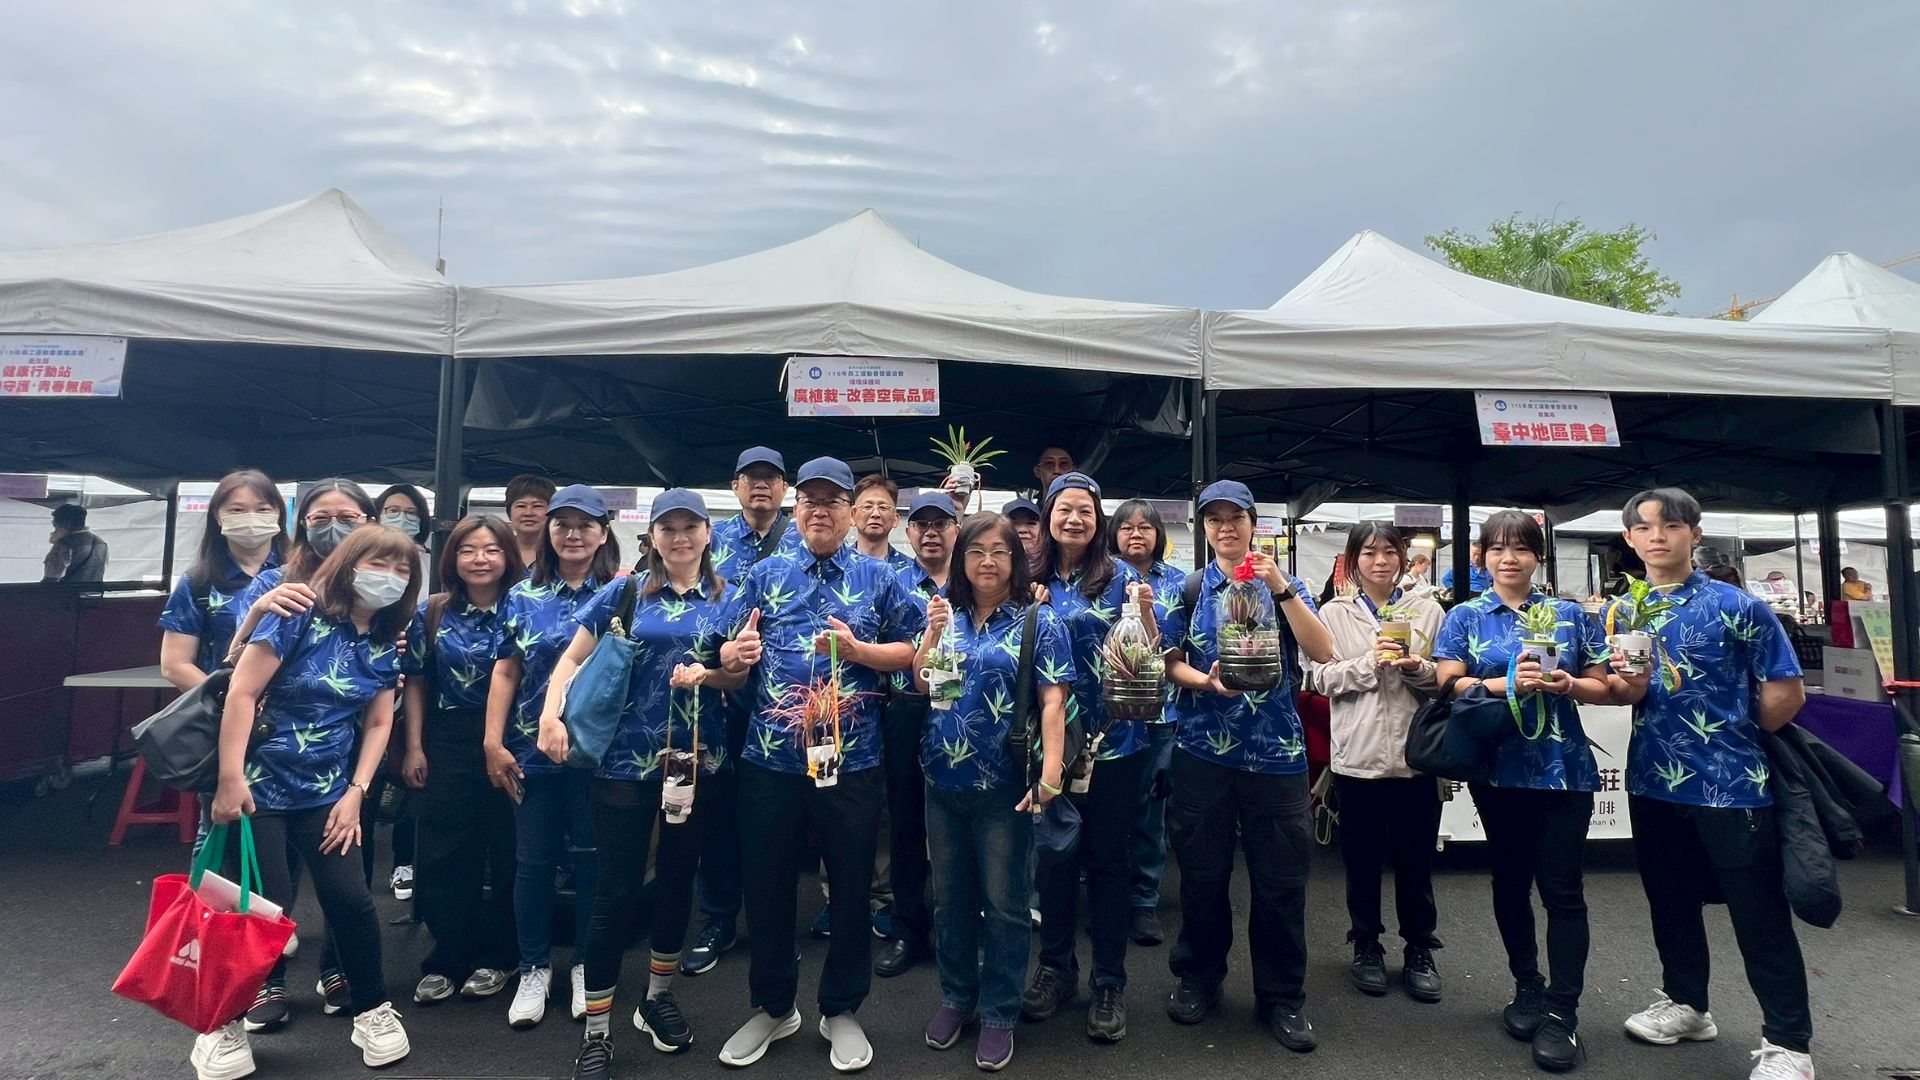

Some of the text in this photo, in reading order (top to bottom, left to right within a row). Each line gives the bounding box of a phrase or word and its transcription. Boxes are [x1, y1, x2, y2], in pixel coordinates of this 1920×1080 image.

[3, 365, 72, 378] 健康行動站
[794, 388, 935, 403] 廣植栽-改善空氣品質
[1492, 422, 1607, 443] 臺中地區農會
